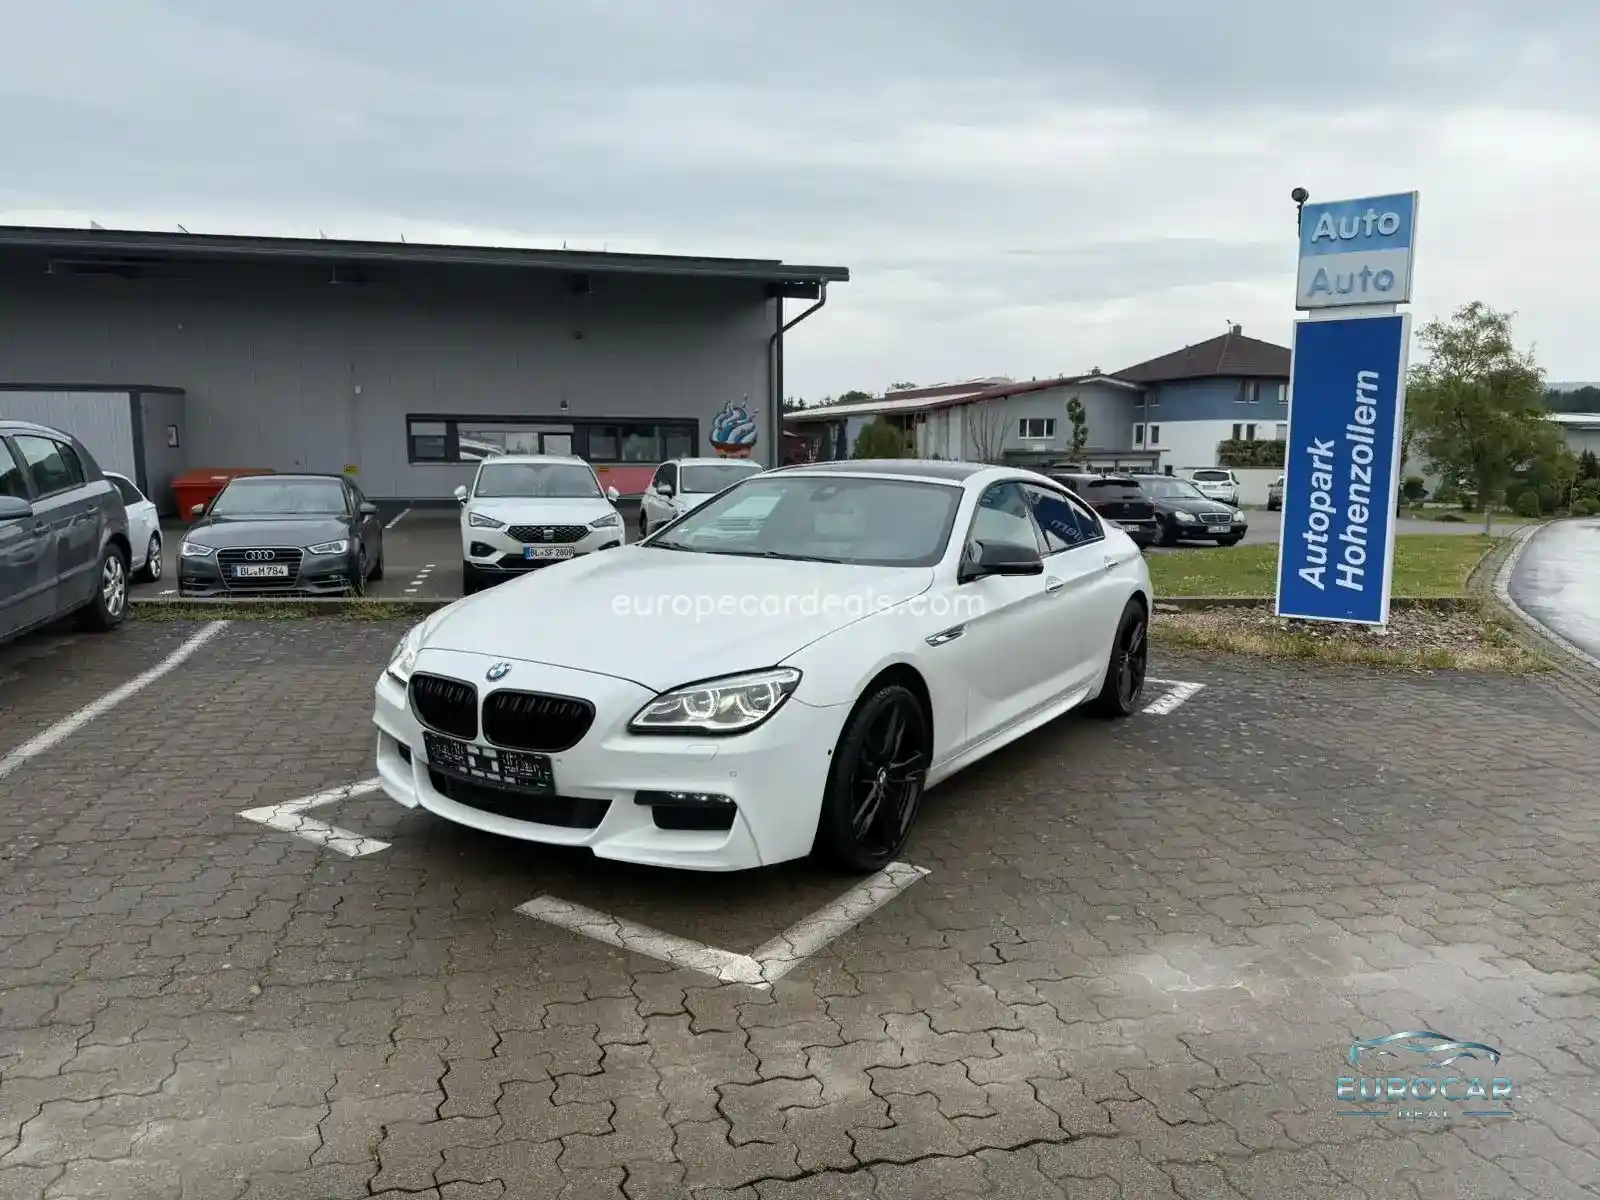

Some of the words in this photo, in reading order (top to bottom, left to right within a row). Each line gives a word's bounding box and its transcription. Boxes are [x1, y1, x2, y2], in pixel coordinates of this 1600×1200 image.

[1311, 208, 1400, 243] Auto
[1307, 262, 1395, 298] Auto
[1335, 369, 1380, 593] Hohenzollern
[1298, 436, 1336, 591] Autopark
[240, 566, 253, 576] BL
[258, 566, 265, 576] M
[266, 566, 284, 576] 784
